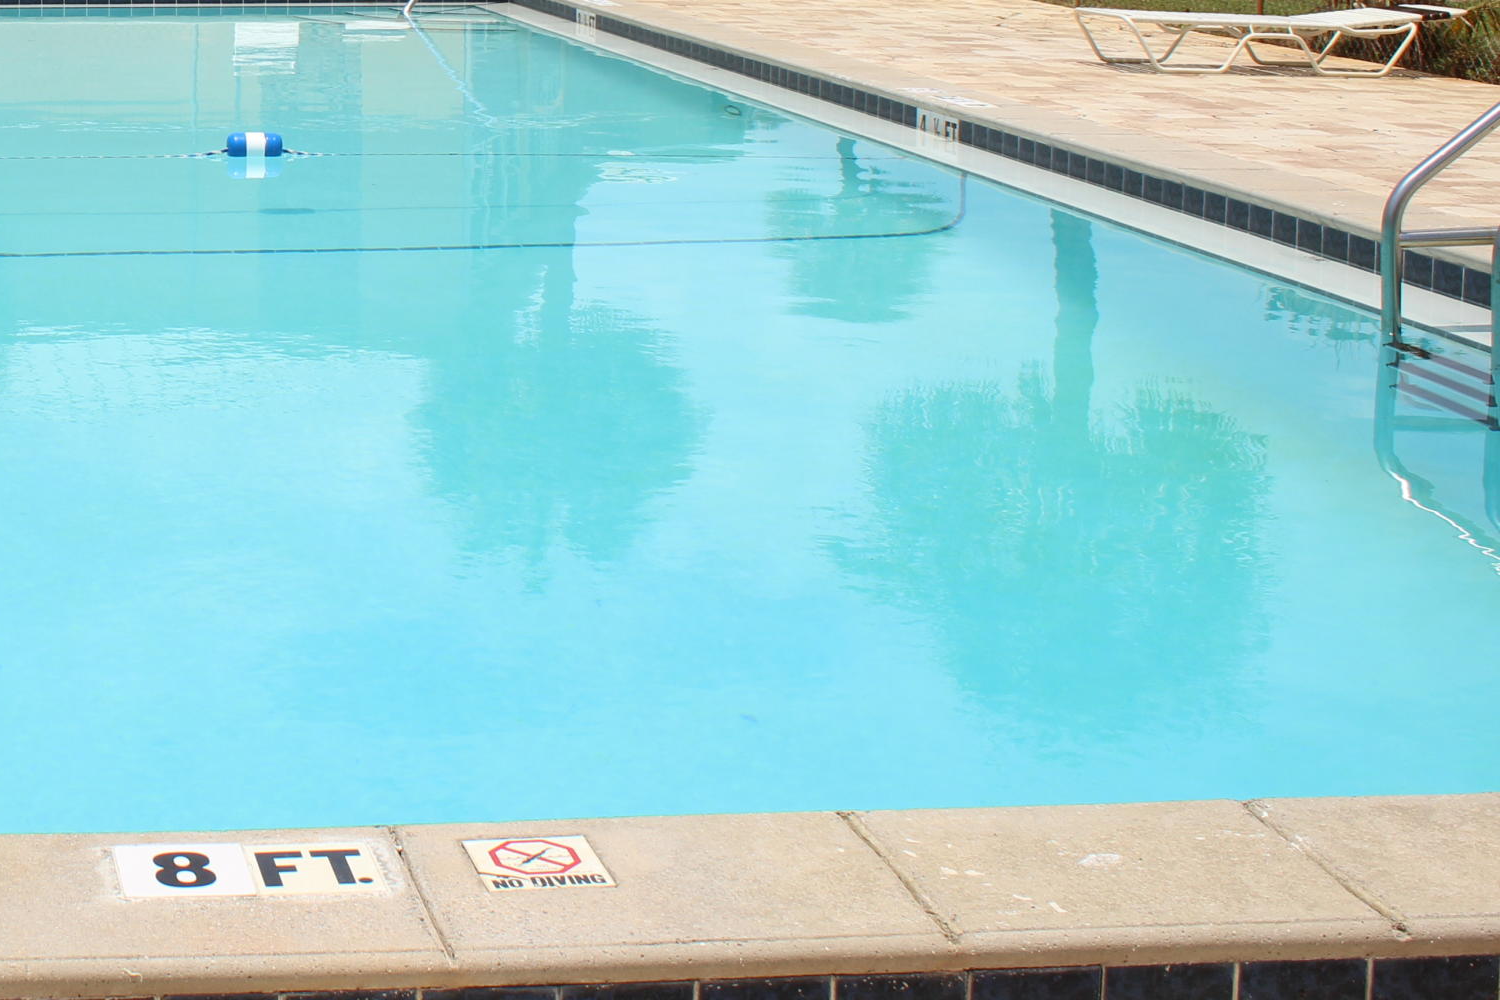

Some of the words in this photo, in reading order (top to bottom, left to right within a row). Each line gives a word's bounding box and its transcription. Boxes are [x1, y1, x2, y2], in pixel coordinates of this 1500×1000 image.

[152, 851, 217, 888] 8
[253, 848, 374, 888] FT.
[491, 878, 525, 890] NO
[531, 873, 608, 888] DIVING
